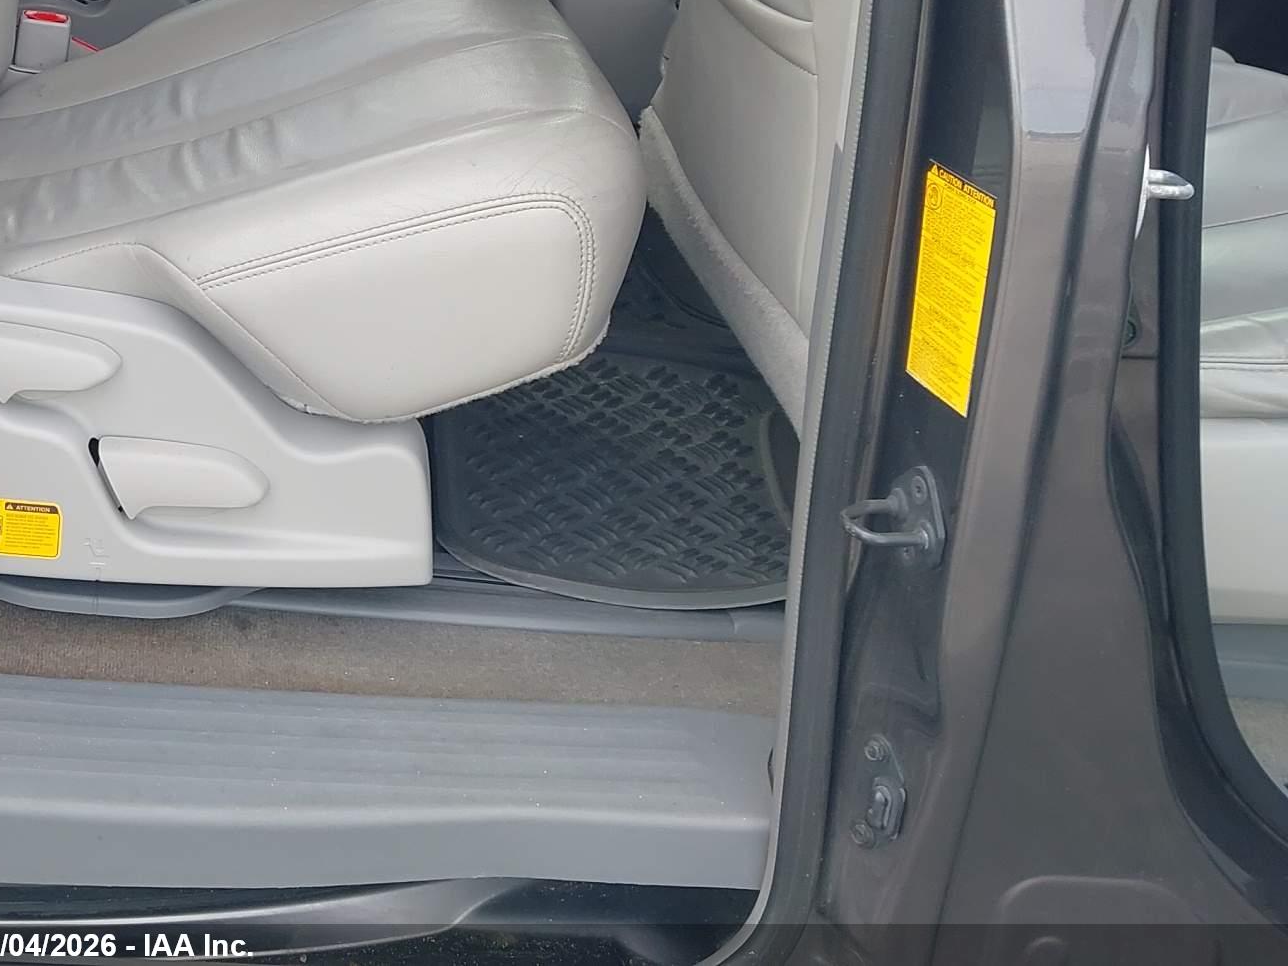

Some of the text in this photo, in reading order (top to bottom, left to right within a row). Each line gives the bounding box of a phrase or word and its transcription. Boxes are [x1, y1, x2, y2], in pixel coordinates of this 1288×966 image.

[939, 169, 963, 190] CAUTION
[963, 183, 994, 208] ATTENTION
[15, 505, 51, 513] ATTENTION
